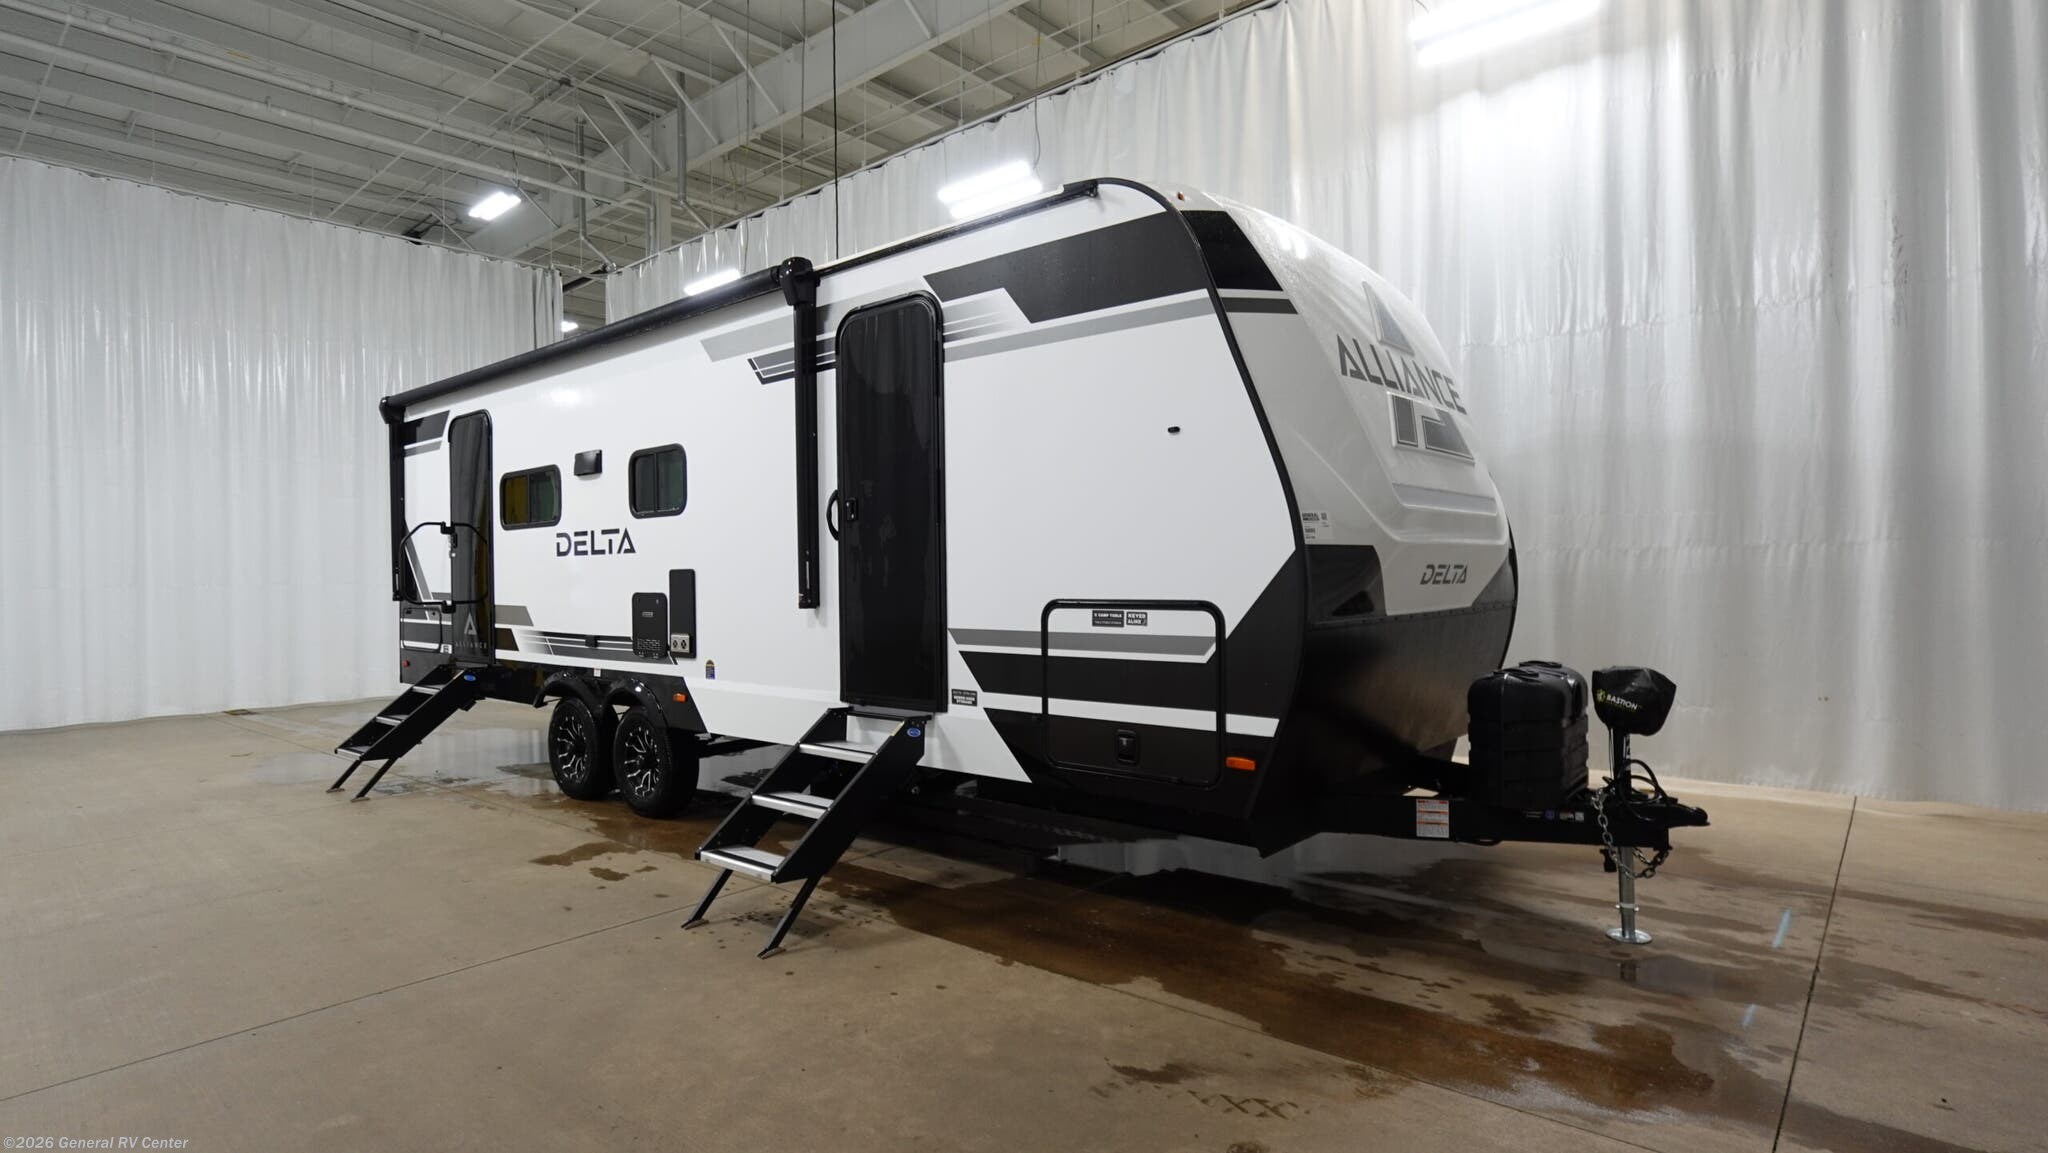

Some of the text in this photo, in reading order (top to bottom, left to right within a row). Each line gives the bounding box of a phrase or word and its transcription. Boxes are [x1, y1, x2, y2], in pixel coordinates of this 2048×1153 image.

[1336, 334, 1467, 415] ALLIANCE
[556, 528, 637, 557] DELTA
[1420, 564, 1468, 585] DELTA
[1606, 693, 1638, 710] BASTION
